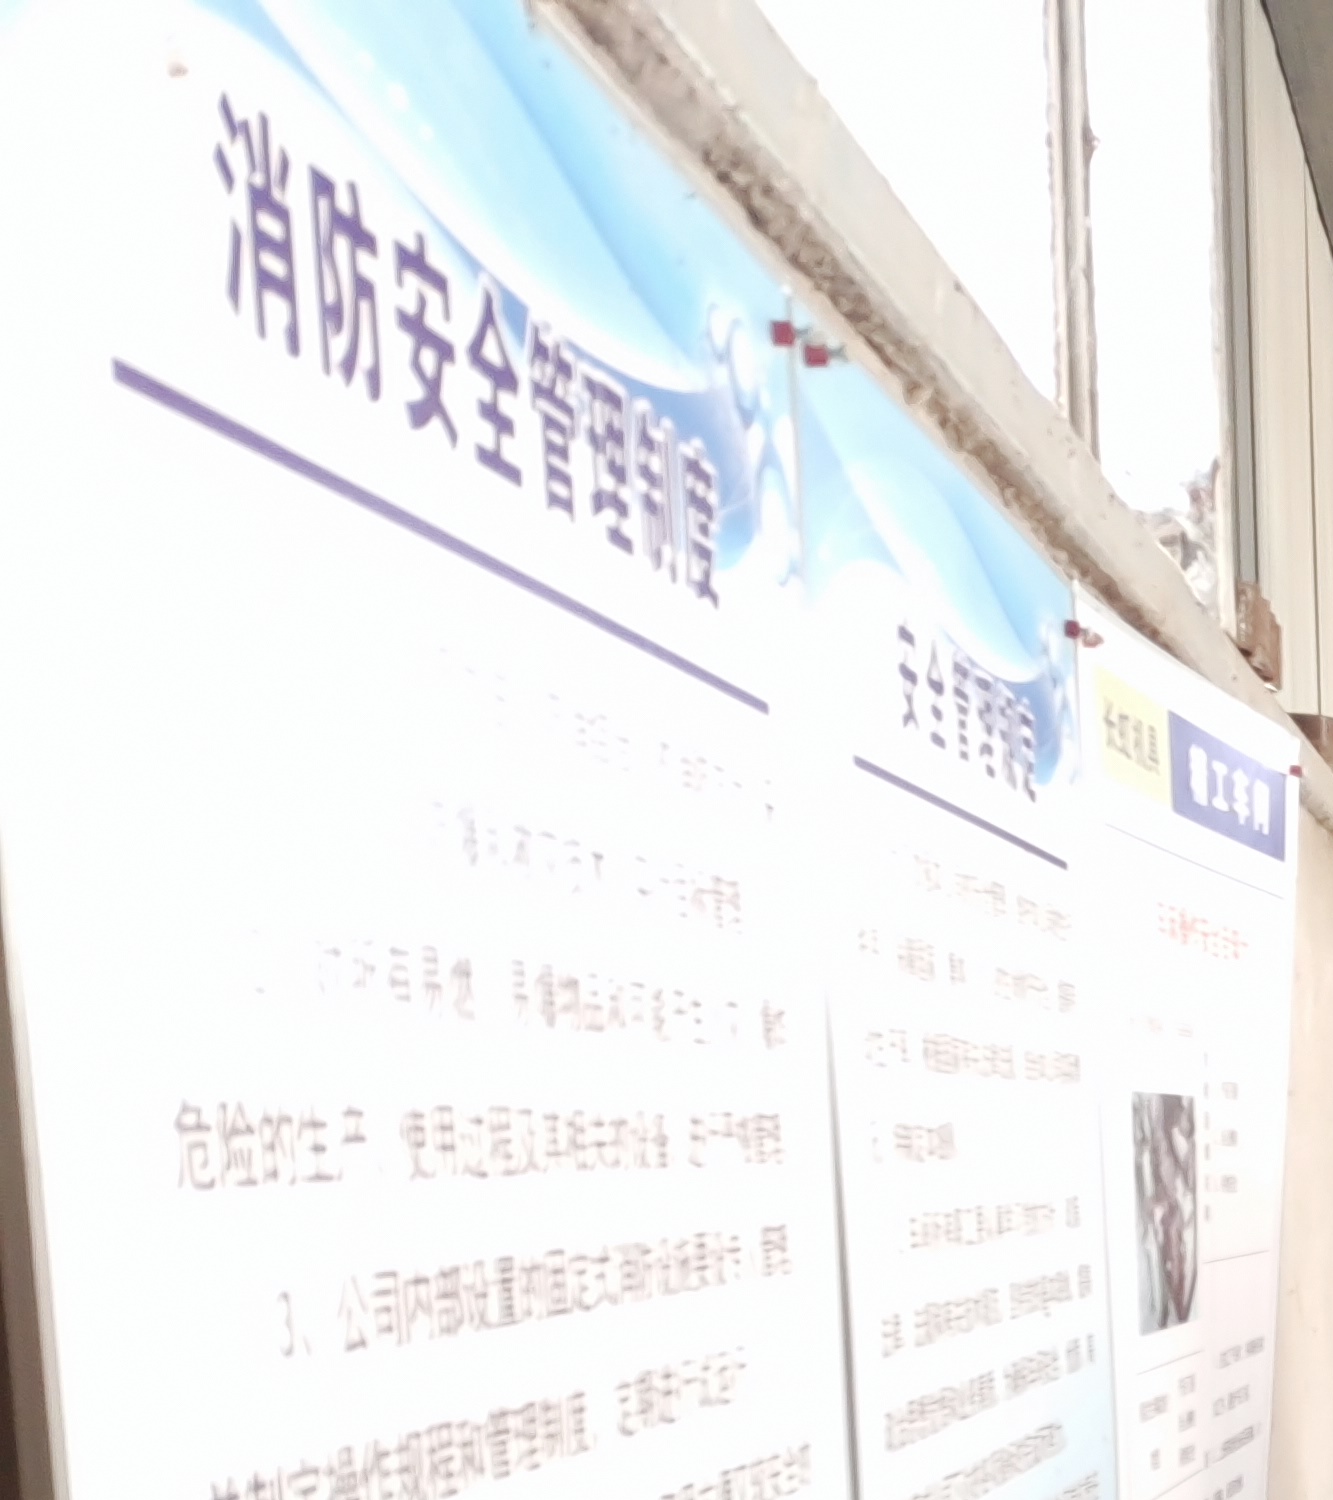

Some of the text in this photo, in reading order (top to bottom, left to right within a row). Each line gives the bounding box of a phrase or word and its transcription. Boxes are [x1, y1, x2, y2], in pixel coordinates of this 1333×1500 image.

[213, 91, 720, 609] 消防安全管理制度
